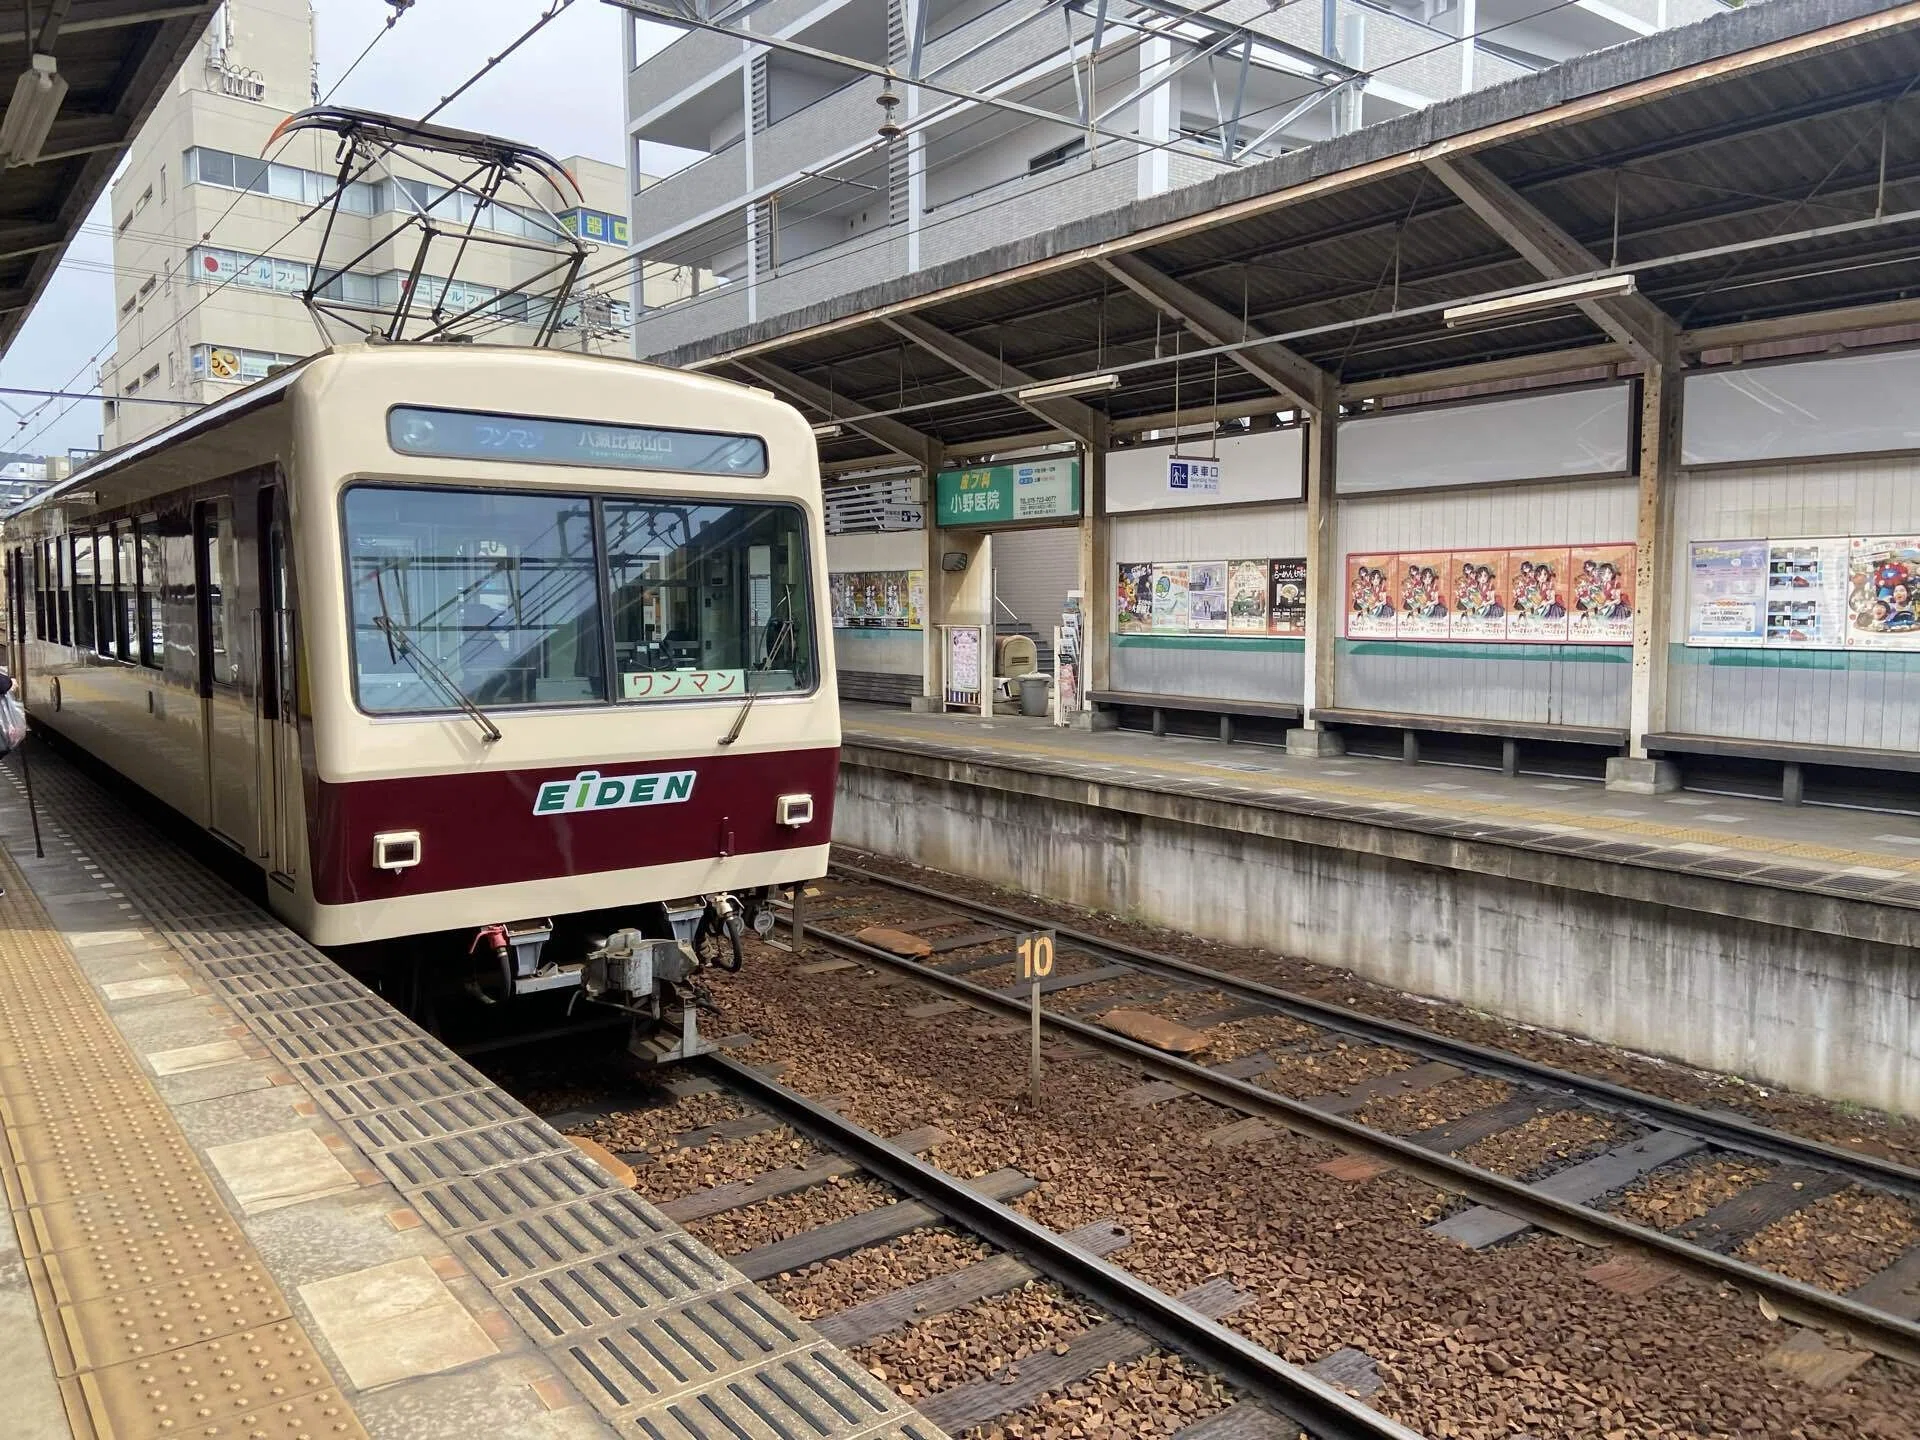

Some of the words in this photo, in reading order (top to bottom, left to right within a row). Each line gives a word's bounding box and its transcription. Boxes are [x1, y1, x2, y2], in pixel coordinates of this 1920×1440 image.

[577, 432, 672, 453] 八瀬比叡山口
[1191, 466, 1218, 477] 乗車口
[950, 490, 1000, 514] 小野医院
[633, 672, 736, 696] ワンマン
[1018, 936, 1053, 977] 10
